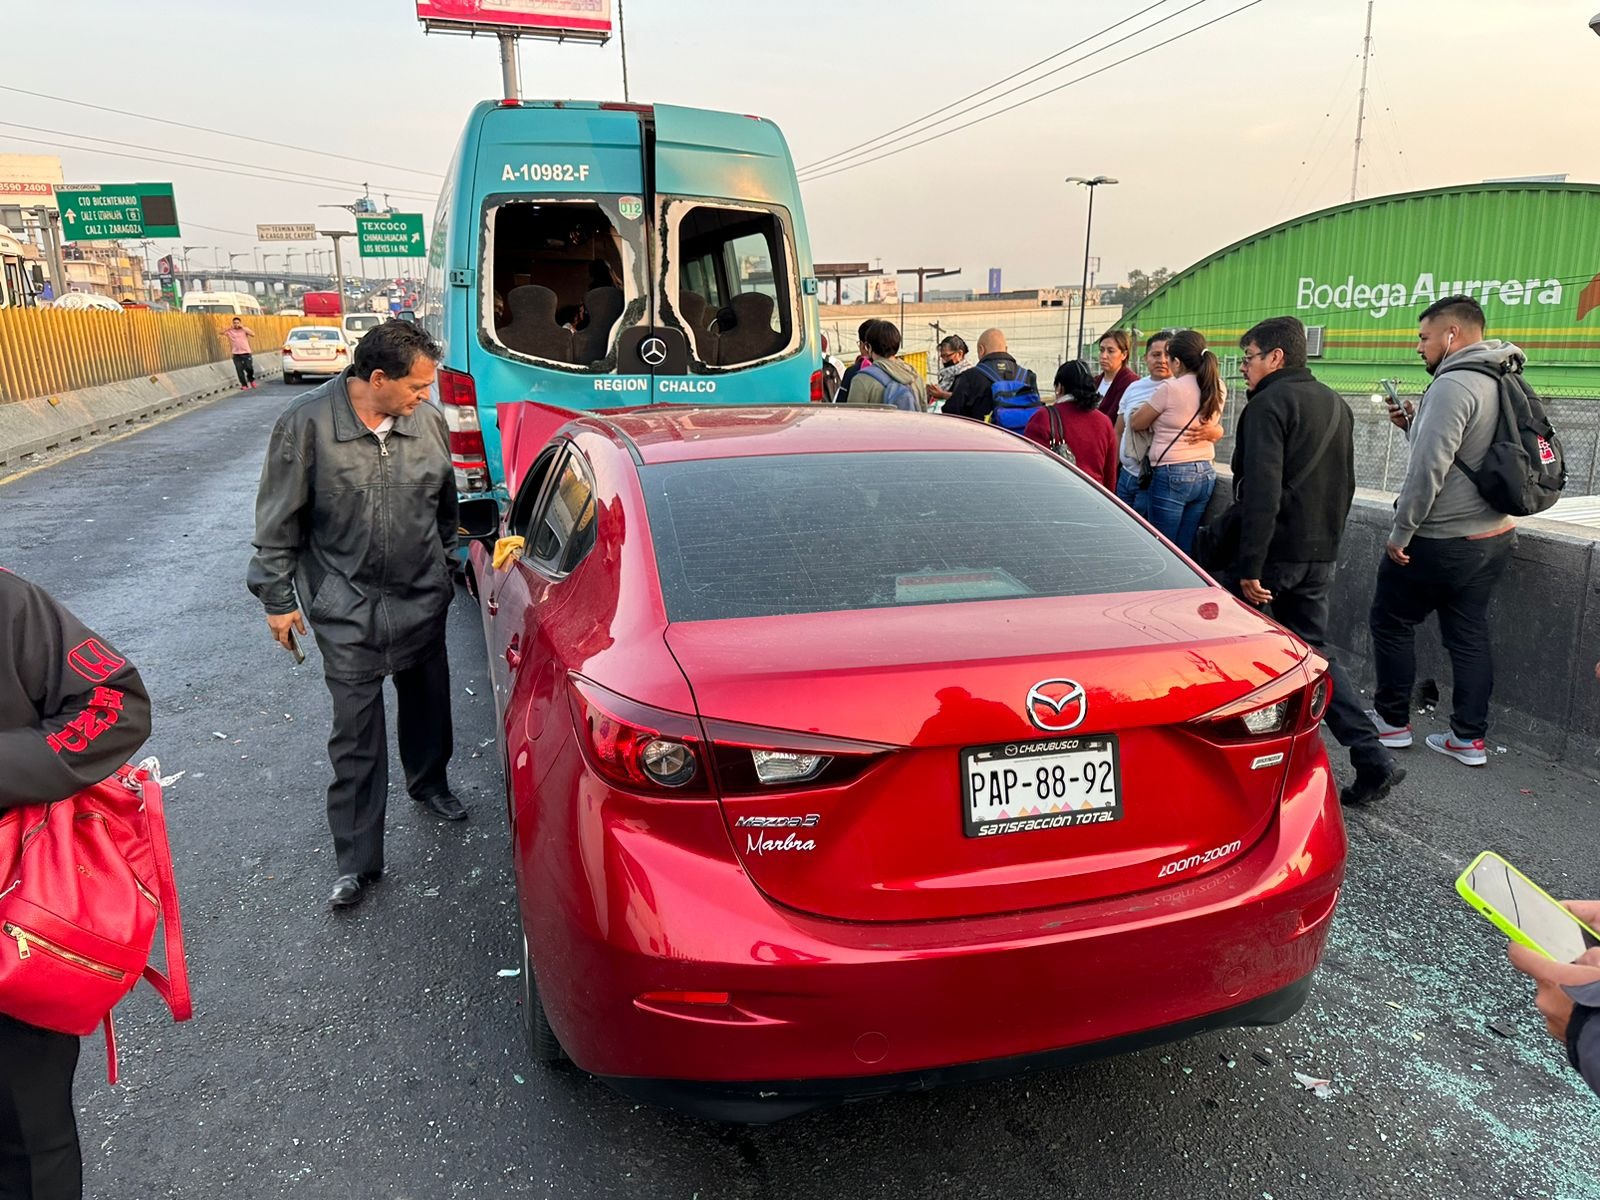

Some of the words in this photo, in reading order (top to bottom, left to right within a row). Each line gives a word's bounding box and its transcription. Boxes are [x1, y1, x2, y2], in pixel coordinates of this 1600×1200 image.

[501, 164, 590, 182] A-10982-F
[23, 183, 47, 192] 2400
[78, 196, 91, 206] CTO
[92, 195, 137, 206] BICENTENARIO
[85, 225, 102, 235] CALZ
[109, 224, 143, 234] ZARAGOZA
[361, 222, 407, 231] TEXCOCO
[362, 233, 408, 242] CHIMALHUACAN
[363, 244, 374, 253] LOS
[374, 244, 390, 253] REYES
[398, 244, 409, 253] PAZ
[1296, 275, 1407, 319] Bodega
[1405, 272, 1563, 308] Aurrera
[594, 378, 648, 391] REGION
[659, 380, 716, 393] CHALCO
[46, 685, 126, 756] HOND
[1018, 739, 1080, 754] CHURUBUSCO
[970, 760, 1114, 809] PAP-88-92
[1076, 810, 1115, 825] TOTAL
[745, 829, 817, 857] Marbra
